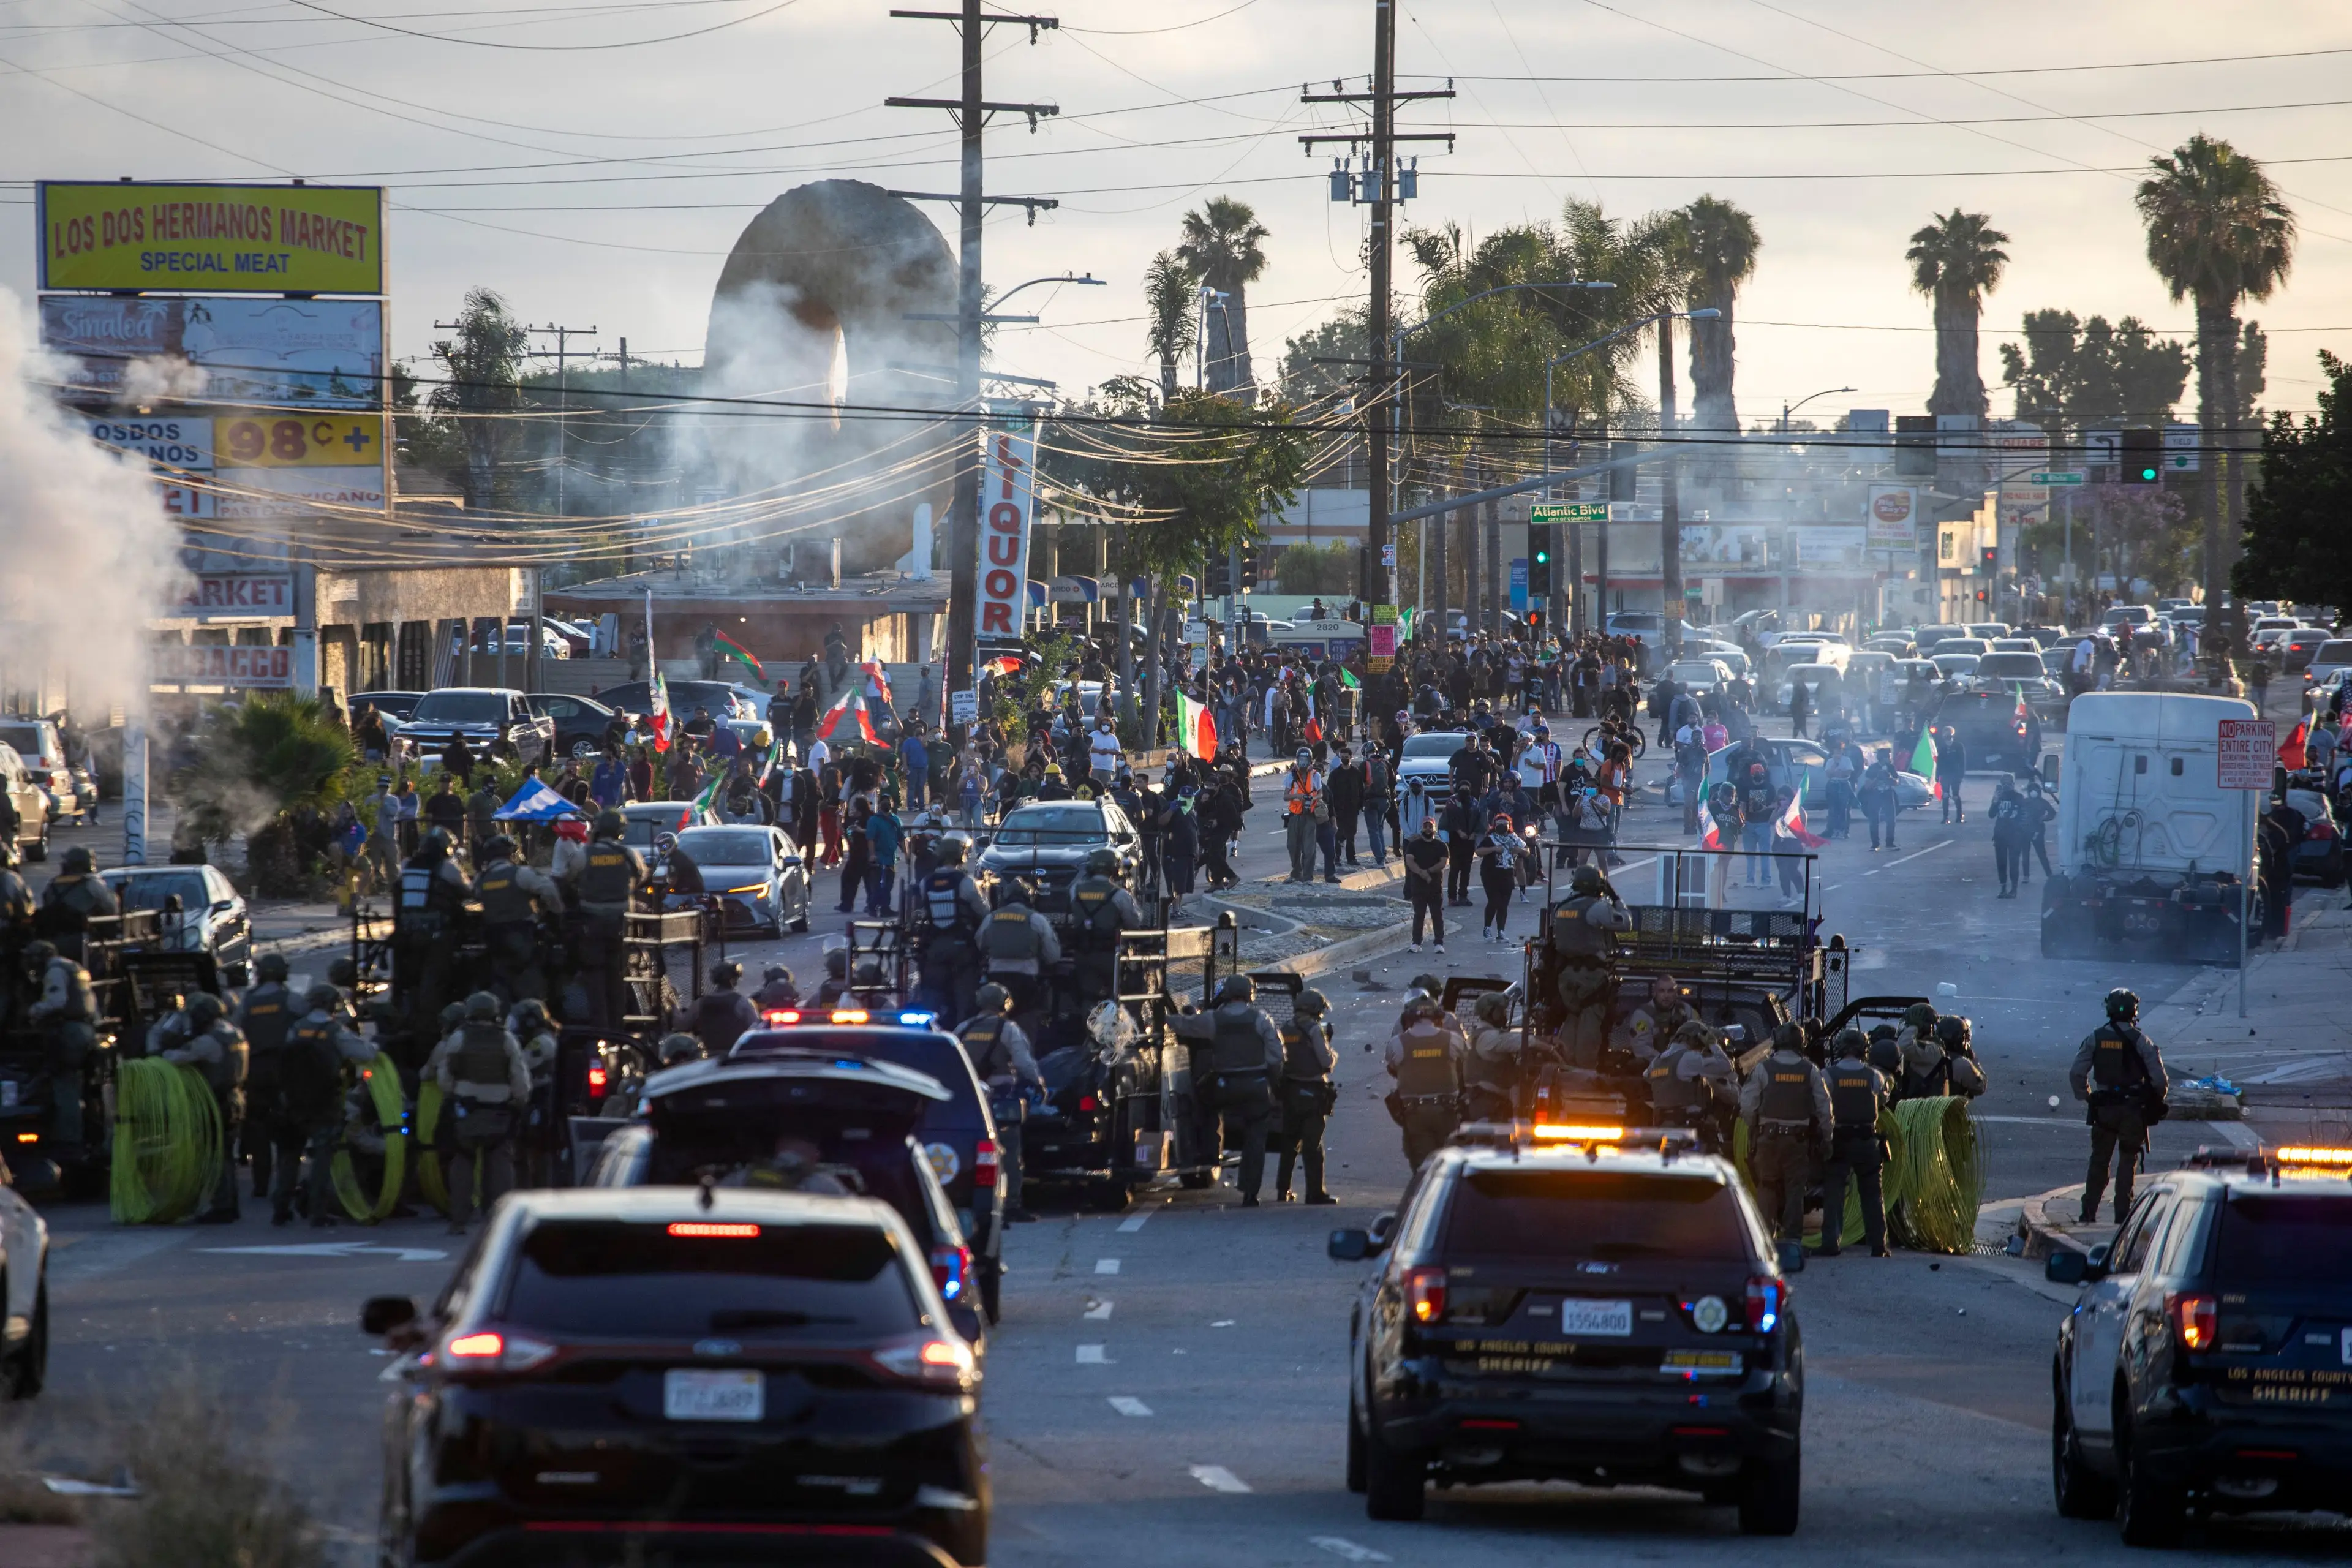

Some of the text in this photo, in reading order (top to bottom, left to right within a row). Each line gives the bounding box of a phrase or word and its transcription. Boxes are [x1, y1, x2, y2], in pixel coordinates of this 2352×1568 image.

[55, 202, 368, 263] LOS DOS HERMANOS MARKET
[140, 252, 290, 273] SPECIAL MEAT
[62, 311, 153, 340] Sinaloa
[1533, 504, 1605, 516] Atlantic Blvd
[982, 434, 1022, 633] LIQUOR
[172, 579, 288, 606] ARKET
[2220, 723, 2272, 737] NO PARKING
[2221, 740, 2272, 753] ENTIRE CITY
[1412, 1048, 1442, 1058] SHERIFF
[1774, 1072, 1806, 1083] SHERIFF
[1839, 1078, 1868, 1087] SHERIFF
[1455, 1340, 1577, 1355] LOS ANGELES COUNTY
[1477, 1357, 1553, 1372] SHERIFF
[2228, 1367, 2248, 1379] LOS
[2254, 1368, 2305, 1382] ANGELES
[2252, 1385, 2331, 1402] SHERIFF
